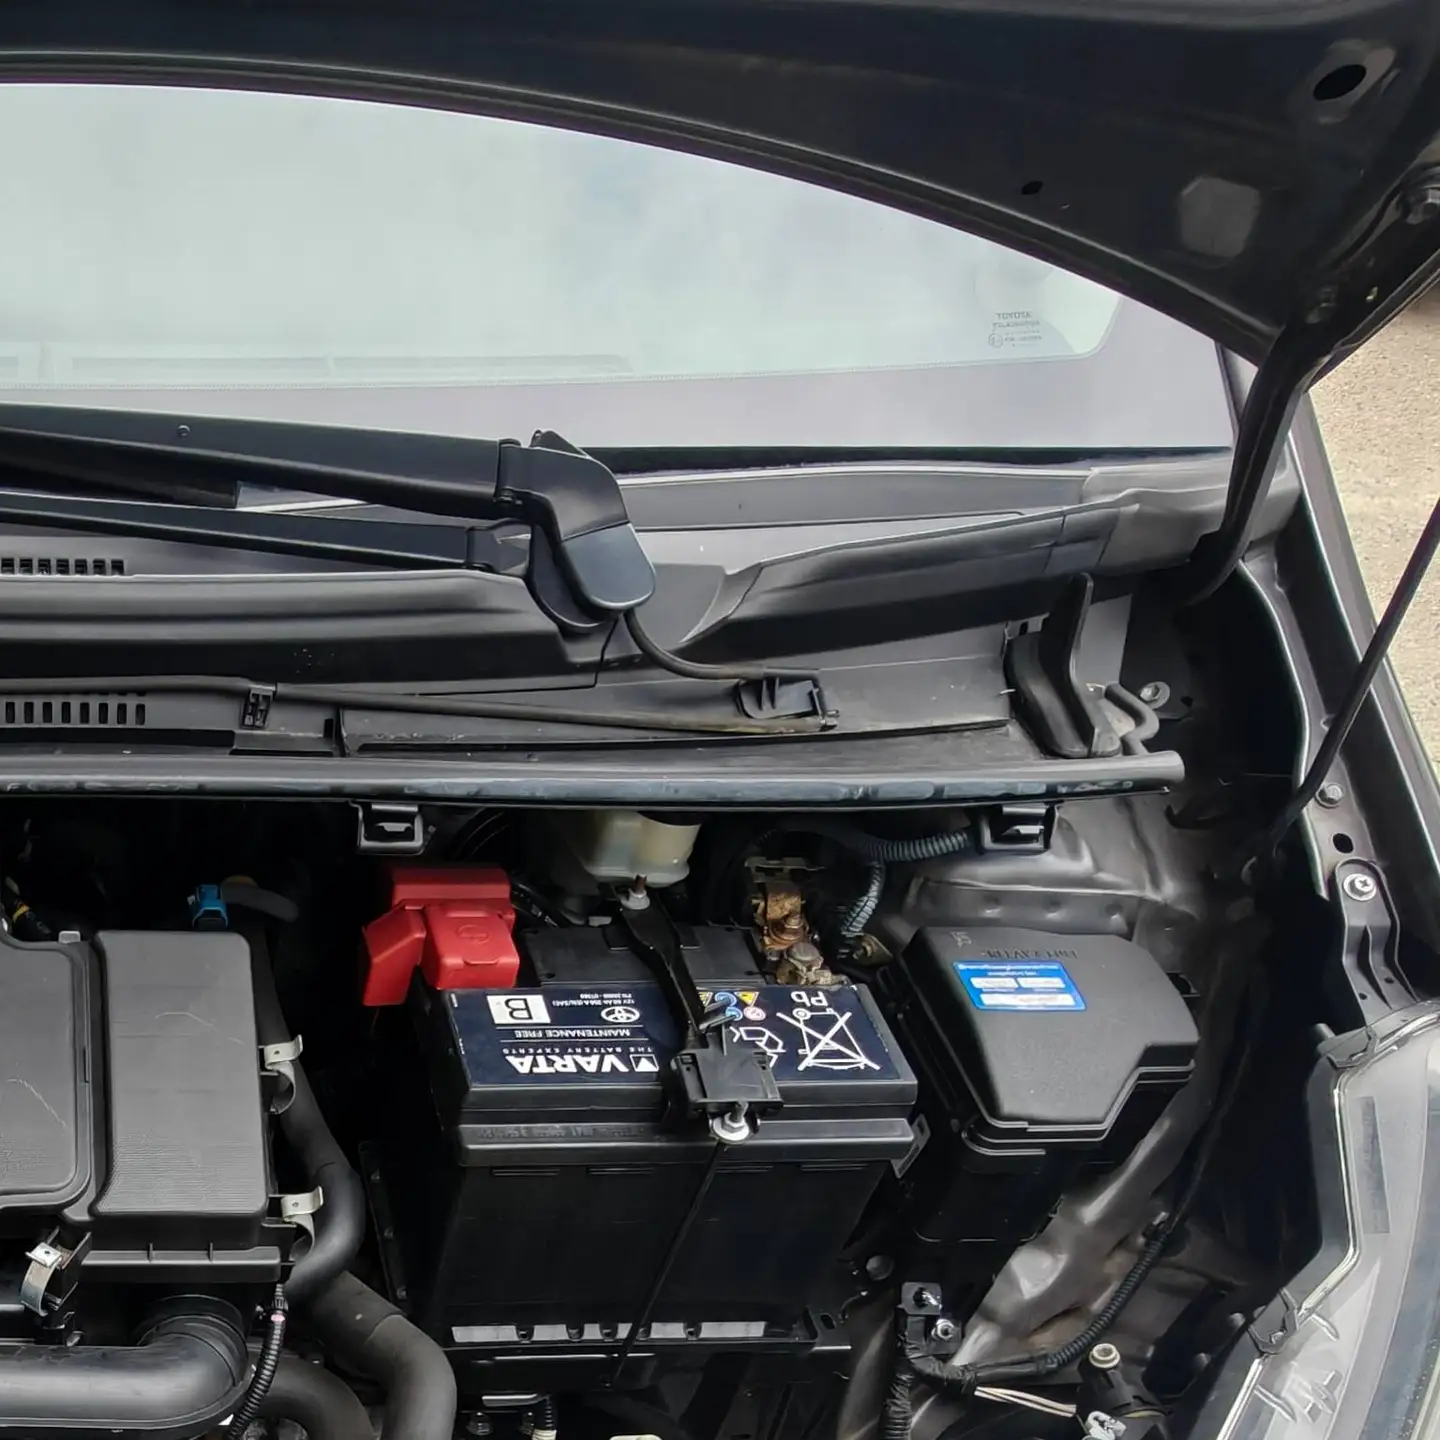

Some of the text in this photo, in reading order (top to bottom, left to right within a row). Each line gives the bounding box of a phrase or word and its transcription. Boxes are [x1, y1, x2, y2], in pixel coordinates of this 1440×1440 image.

[791, 991, 828, 1007] Pb
[504, 998, 533, 1020] B
[514, 1029, 631, 1039] MAINTENANCE FREE
[505, 1054, 630, 1073] VARTA
